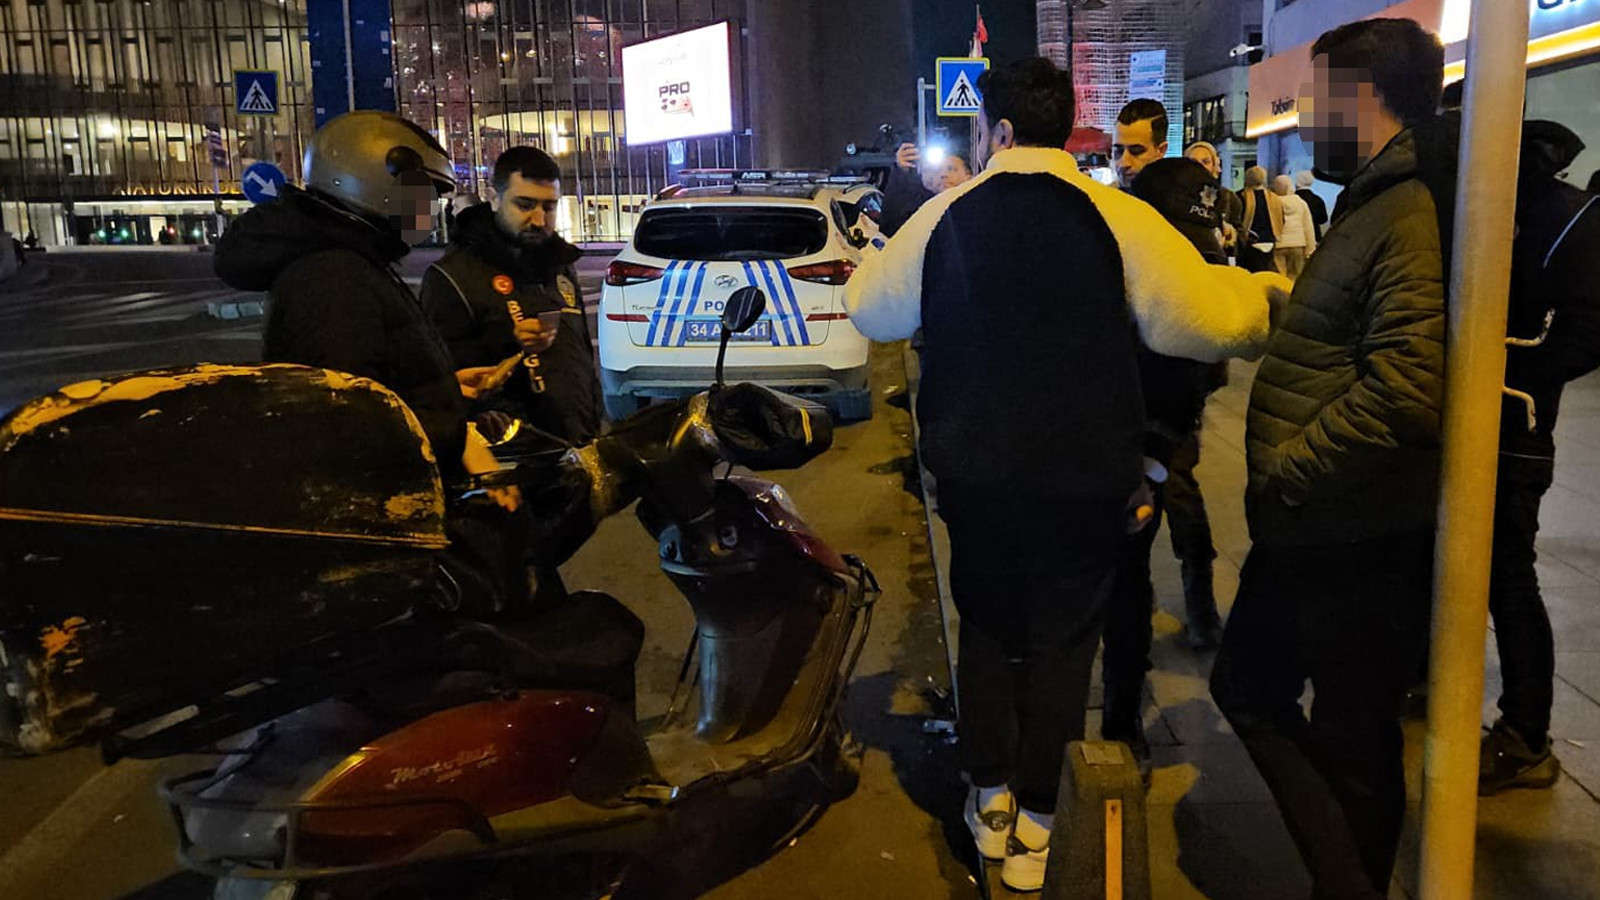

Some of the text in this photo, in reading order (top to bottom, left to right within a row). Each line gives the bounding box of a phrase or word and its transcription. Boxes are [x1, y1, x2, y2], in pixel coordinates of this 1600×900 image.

[658, 81, 691, 98] PRO
[1189, 205, 1213, 219] POL
[691, 323, 708, 337] 34
